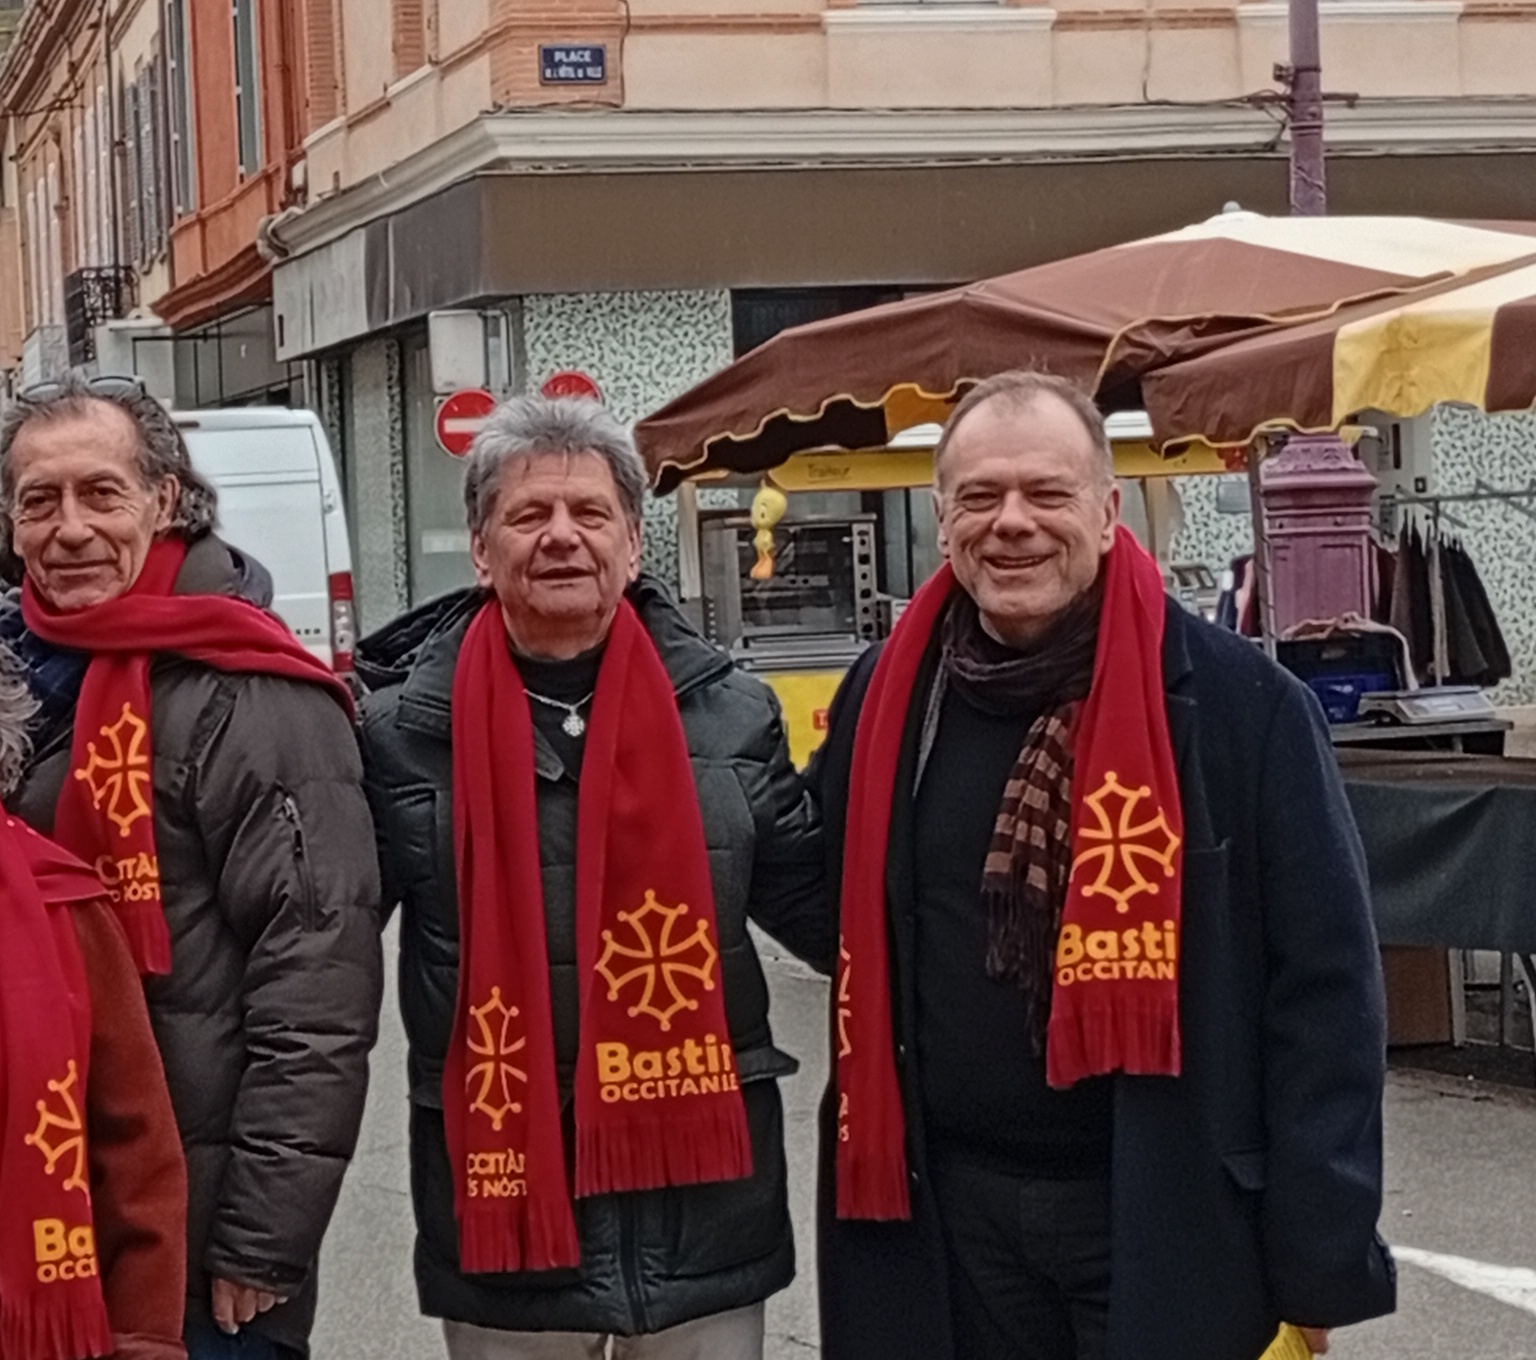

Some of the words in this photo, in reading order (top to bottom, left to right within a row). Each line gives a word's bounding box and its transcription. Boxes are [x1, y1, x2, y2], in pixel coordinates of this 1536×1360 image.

[553, 50, 592, 63] PLACE
[1056, 919, 1176, 969] Basti
[1057, 960, 1175, 987] OCCITAN
[33, 1217, 95, 1262] Ba
[37, 1257, 97, 1283] OCCI
